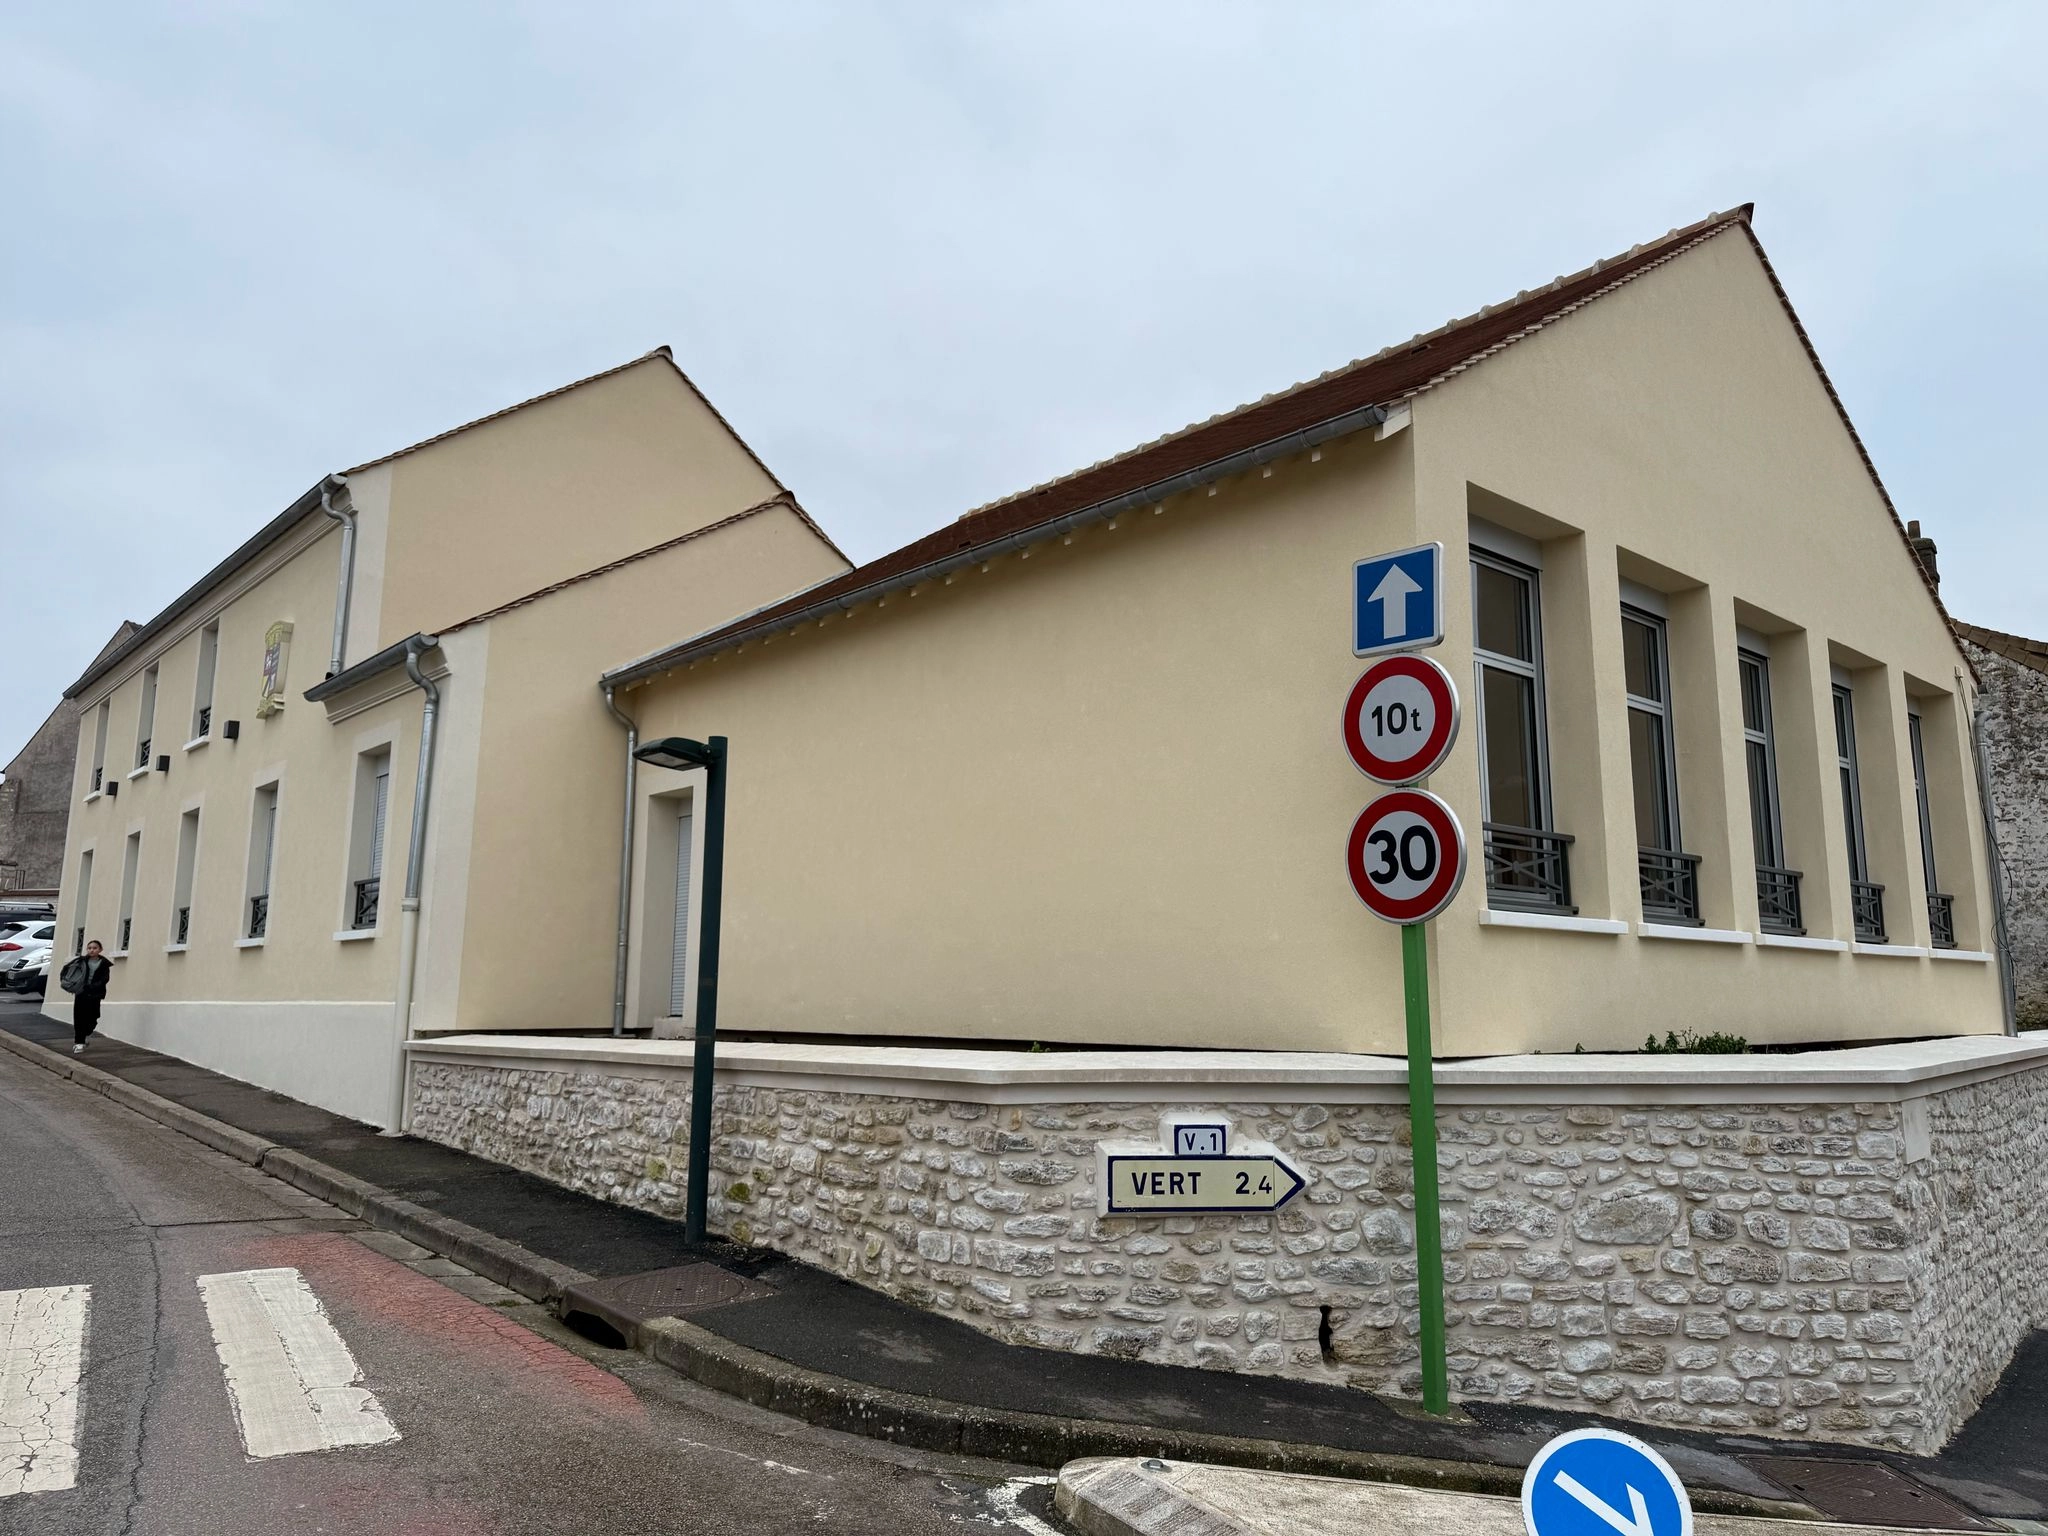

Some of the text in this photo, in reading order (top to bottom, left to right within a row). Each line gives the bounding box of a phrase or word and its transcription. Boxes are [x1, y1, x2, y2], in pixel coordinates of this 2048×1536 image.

[1371, 702, 1422, 737] 10t
[1367, 824, 1437, 885] 30
[1184, 1132, 1217, 1152] V.1
[1131, 1171, 1202, 1196] VERT
